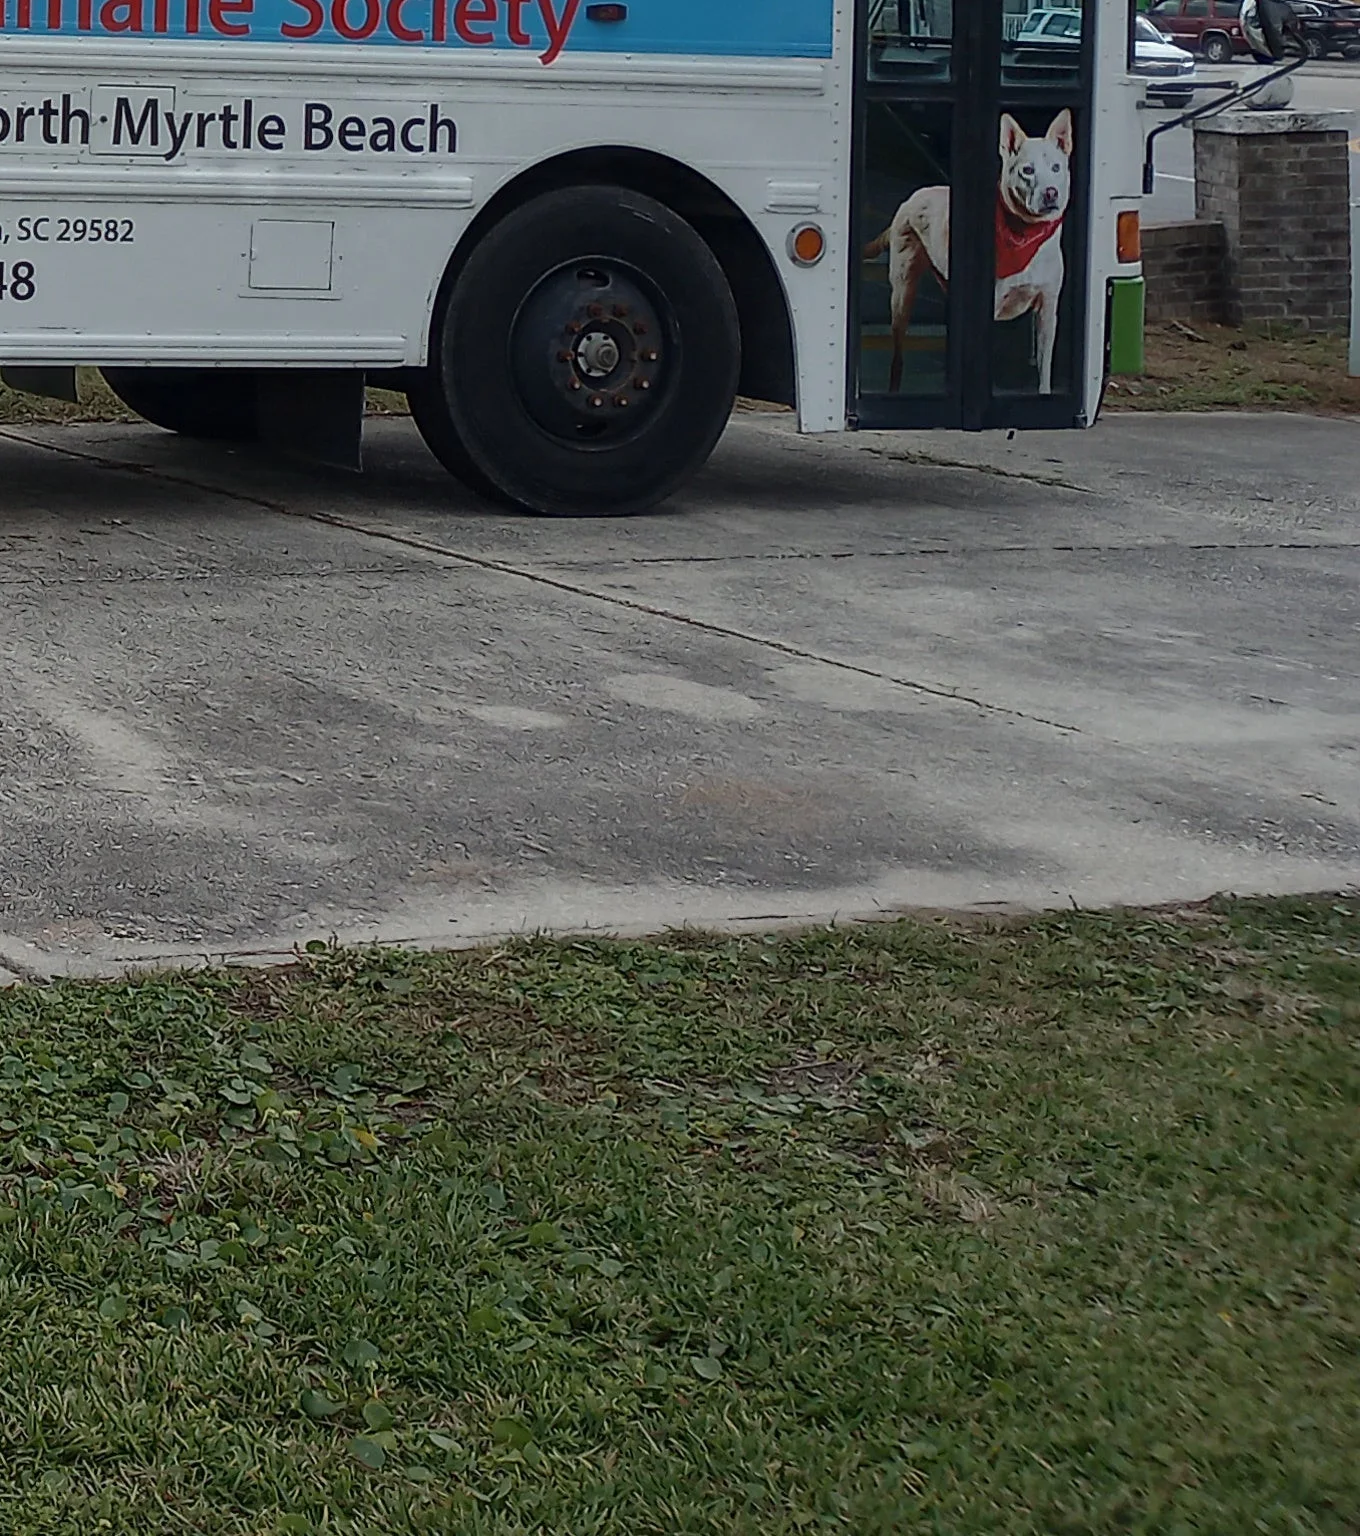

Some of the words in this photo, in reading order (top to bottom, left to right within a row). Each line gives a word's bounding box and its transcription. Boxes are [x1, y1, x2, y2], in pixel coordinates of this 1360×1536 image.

[110, 97, 286, 162] Myrtle
[303, 102, 457, 153] Beach
[17, 217, 50, 242] SC
[56, 218, 134, 242] 29582
